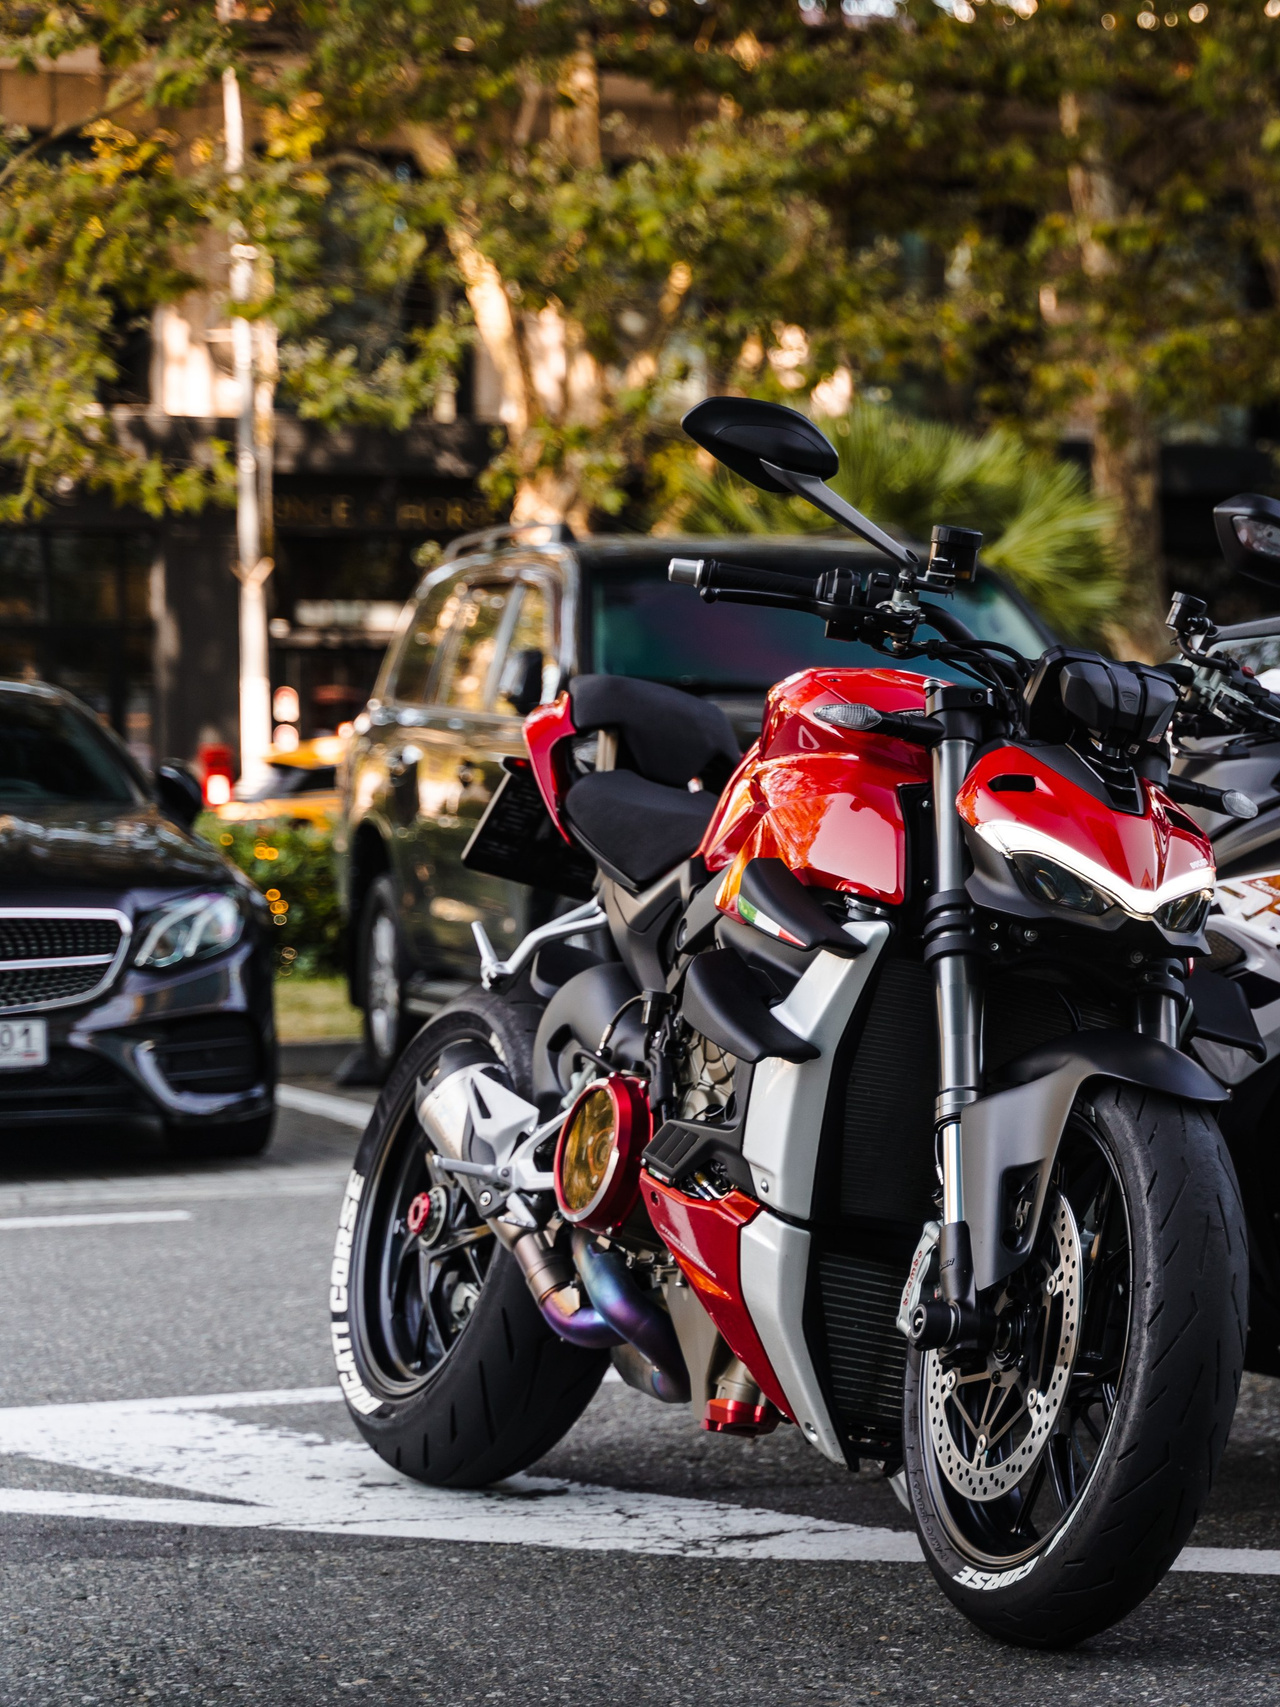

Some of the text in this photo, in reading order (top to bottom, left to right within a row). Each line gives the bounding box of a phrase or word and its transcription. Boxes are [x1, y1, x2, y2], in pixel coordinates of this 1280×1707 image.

[329, 1168, 384, 1415] DUCATI CORSE
[903, 1250, 922, 1307] brembo
[952, 1555, 1040, 1591] CORSE
